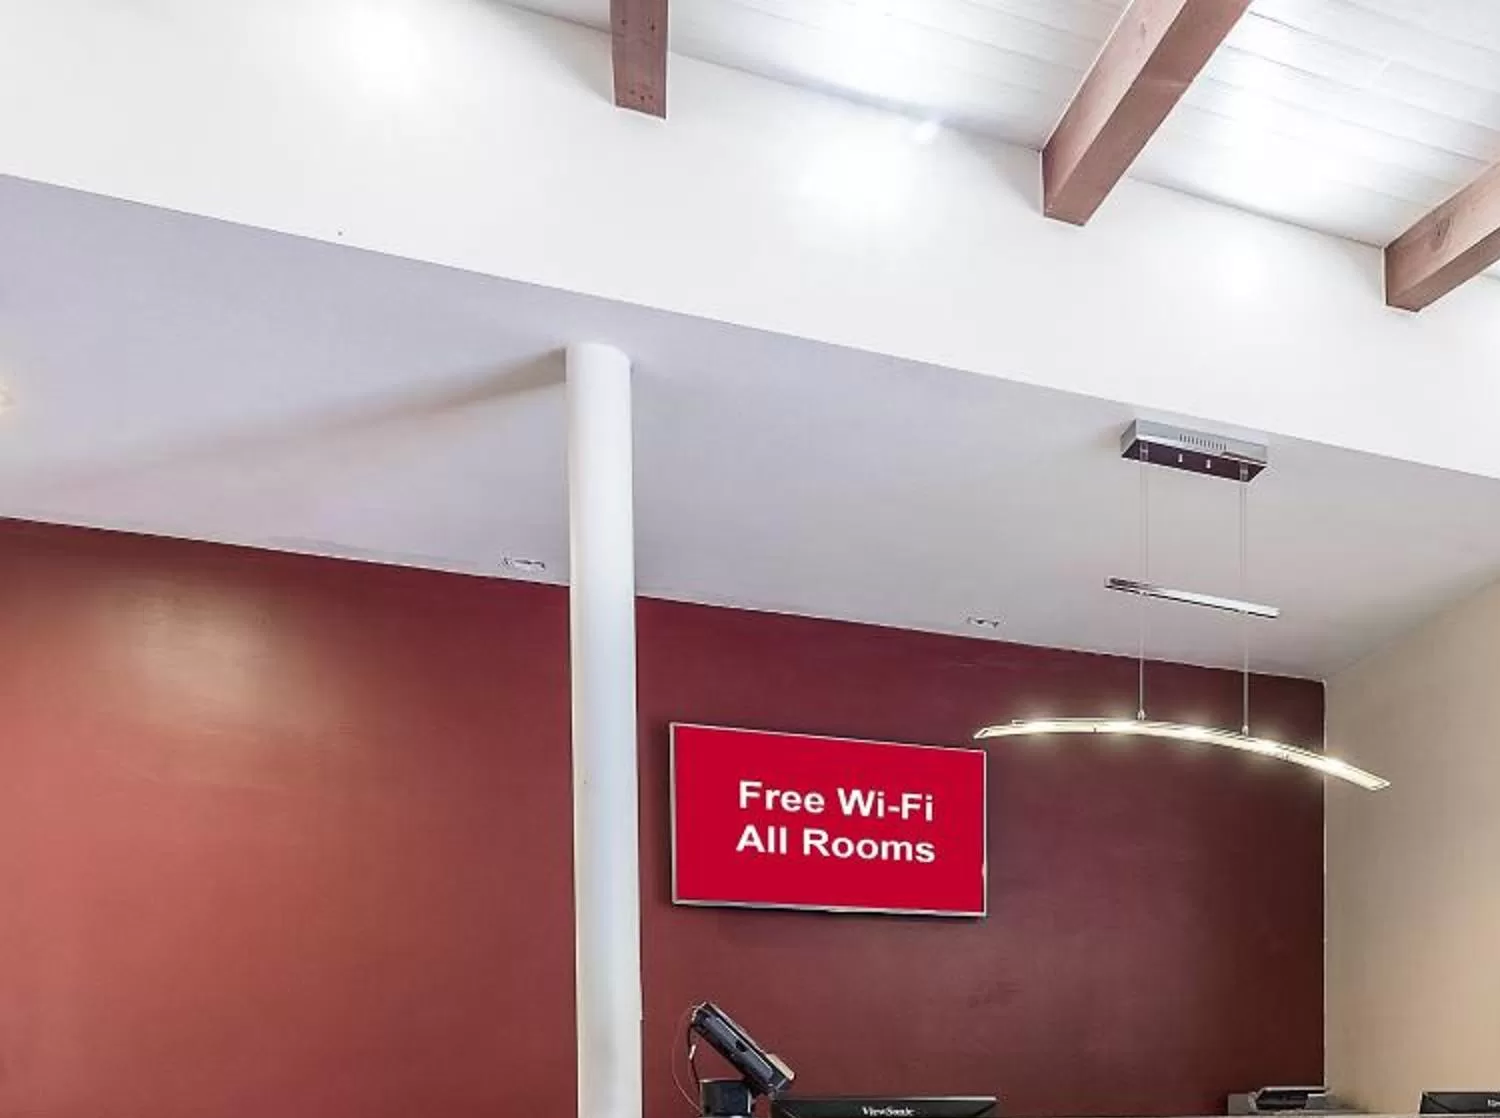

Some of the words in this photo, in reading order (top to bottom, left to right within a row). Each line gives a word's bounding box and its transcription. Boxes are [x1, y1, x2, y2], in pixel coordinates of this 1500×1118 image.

[738, 780, 825, 814] Free
[837, 787, 934, 821] Wi-Fi
[735, 824, 787, 855] All
[803, 827, 936, 863] Rooms
